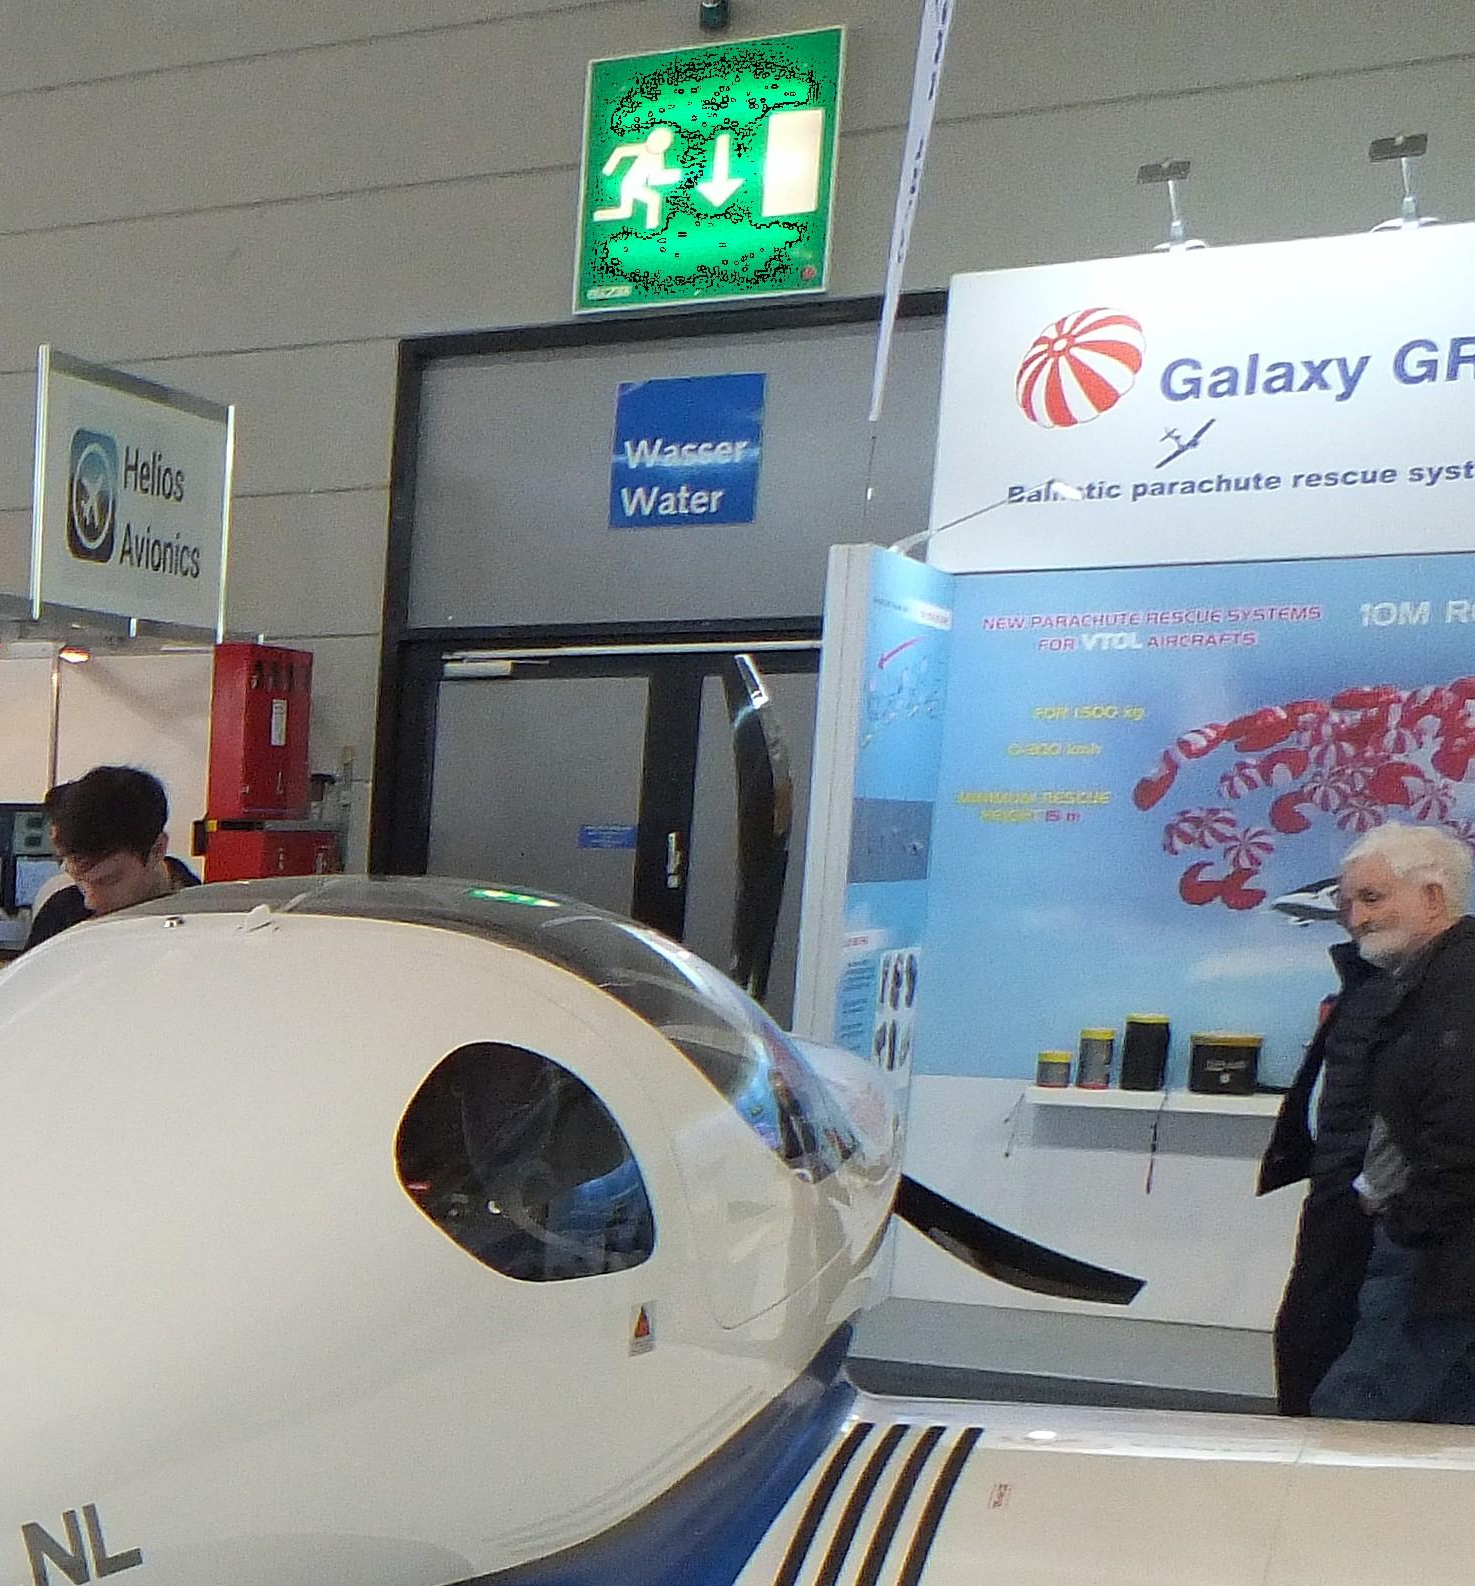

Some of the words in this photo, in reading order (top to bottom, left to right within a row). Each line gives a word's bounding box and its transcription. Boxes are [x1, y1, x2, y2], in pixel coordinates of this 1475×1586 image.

[1160, 351, 1371, 402] Galaxy
[624, 437, 749, 469] Wasser
[123, 445, 185, 502] Helios
[1008, 479, 1122, 504] Baltic
[1131, 472, 1282, 502] parachute
[1292, 467, 1398, 487] rescue
[620, 484, 724, 517] Water
[119, 522, 200, 579] Avionics
[982, 617, 1024, 631] NEW
[1031, 612, 1141, 629] PARACHUTE
[1146, 609, 1221, 625] RESCUE
[1227, 605, 1321, 622] SYSTEMS
[1037, 638, 1076, 651] FOR
[1081, 631, 1143, 651] VTOL
[1147, 630, 1257, 649] AIRCRAFTS
